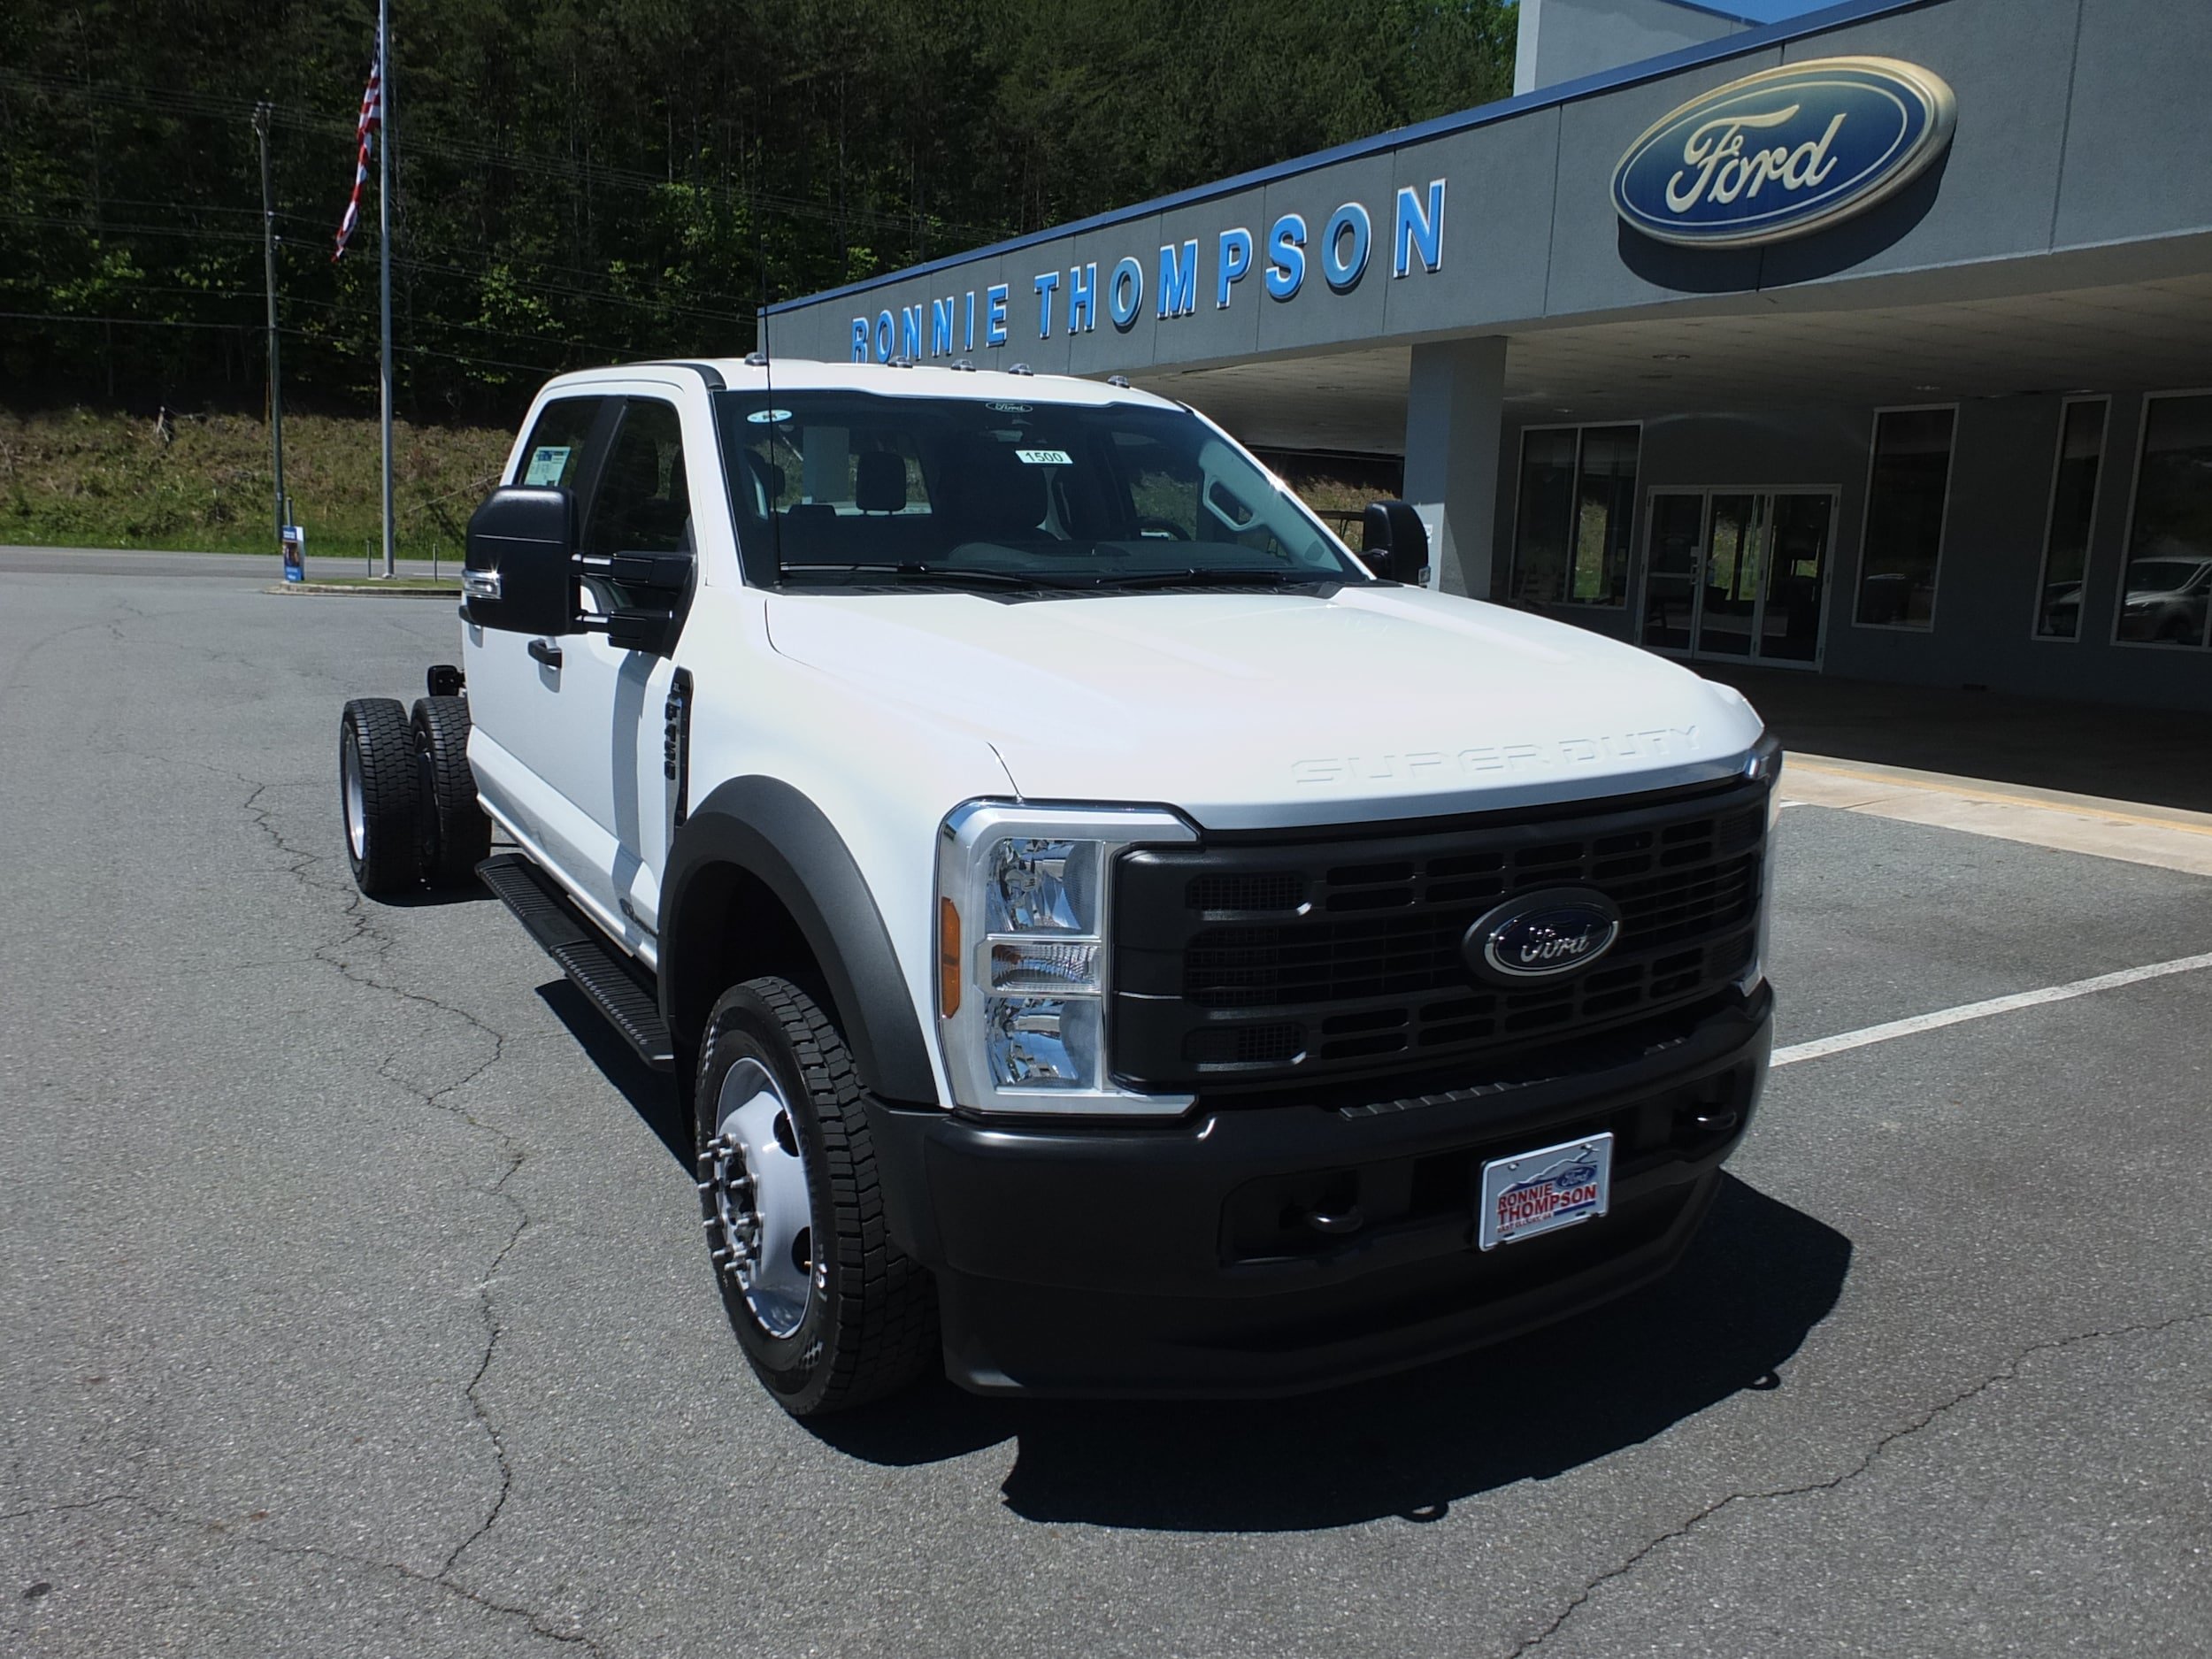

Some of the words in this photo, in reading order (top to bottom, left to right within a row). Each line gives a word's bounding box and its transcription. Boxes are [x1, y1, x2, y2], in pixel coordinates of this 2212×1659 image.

[1665, 104, 1847, 213] Ford
[852, 282, 1009, 364] RONNIE
[1033, 179, 1447, 339] THOMPSON
[1025, 452, 1064, 462] 1500
[1291, 743, 1552, 783] SUPER
[1558, 726, 1702, 765] DUTY
[1520, 918, 1592, 963] Ford
[1497, 1183, 1553, 1210] RONNIE
[1562, 1167, 1590, 1187] Ford
[1497, 1184, 1598, 1225] THOMPSON
